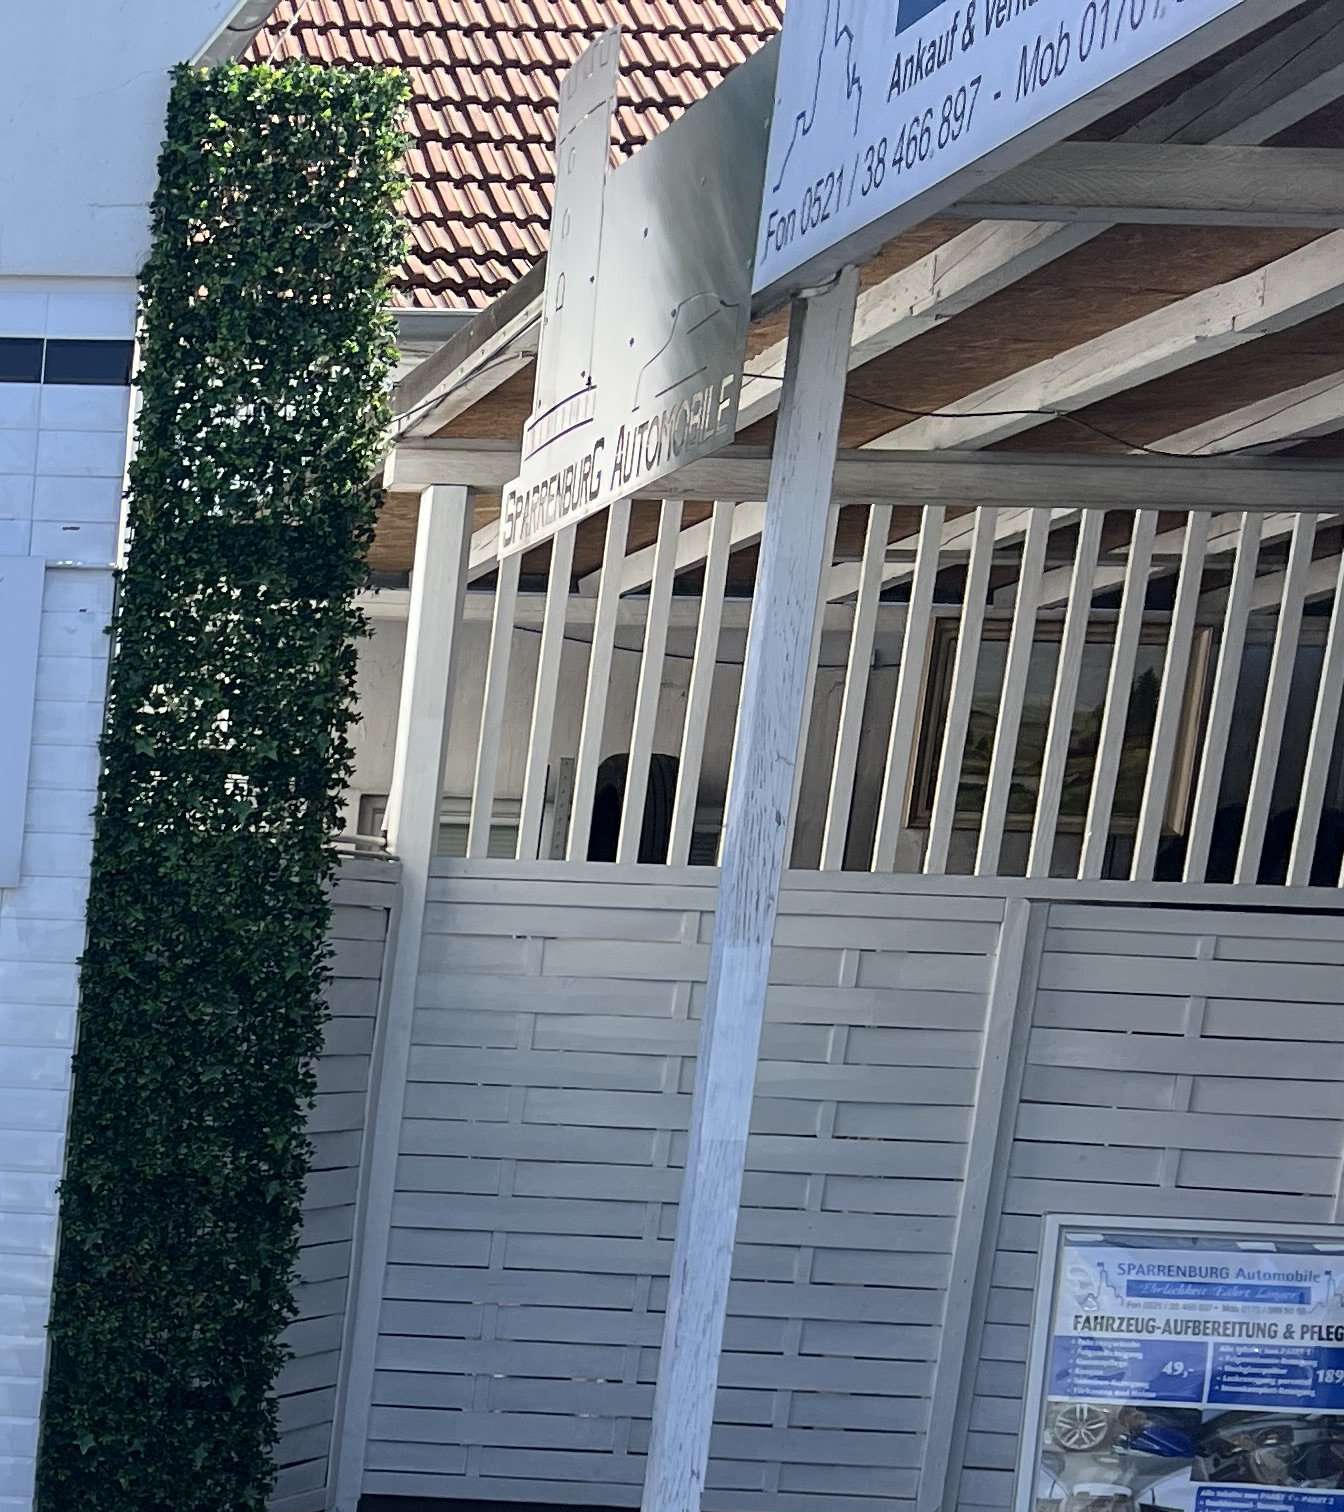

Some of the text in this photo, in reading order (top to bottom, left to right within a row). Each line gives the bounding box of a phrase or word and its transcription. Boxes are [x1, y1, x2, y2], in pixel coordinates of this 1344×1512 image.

[886, 10, 961, 103] Ankauf
[961, 1, 977, 52] &
[760, 208, 797, 266] Fon
[800, 163, 845, 233] 0521
[861, 137, 888, 197] 38
[1015, 20, 1071, 103] Mob
[503, 373, 735, 548] SPARRENBURG AUTOMOBILE
[1116, 1261, 1321, 1283] SPARRENBURG Automobile
[1072, 1314, 1278, 1341] FAHRZEUG-AUFBEREITUNG
[1282, 1322, 1296, 1340] &
[1162, 1360, 1195, 1378] 49,-
